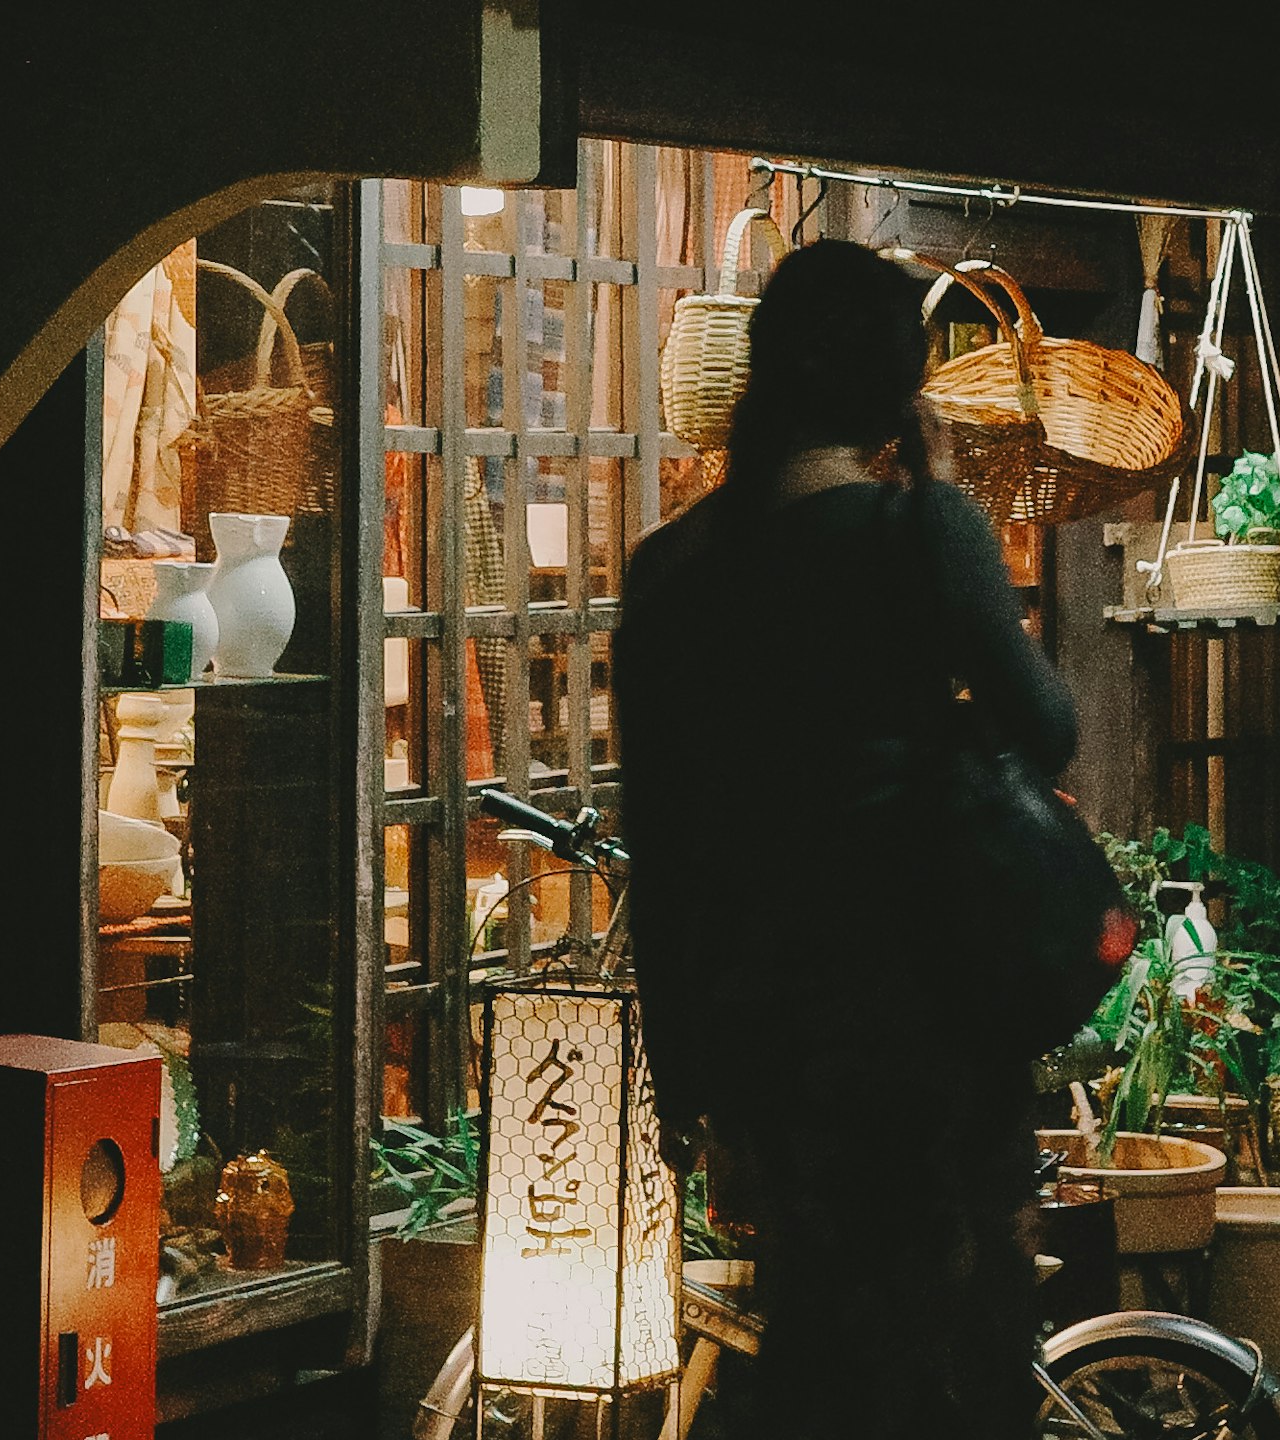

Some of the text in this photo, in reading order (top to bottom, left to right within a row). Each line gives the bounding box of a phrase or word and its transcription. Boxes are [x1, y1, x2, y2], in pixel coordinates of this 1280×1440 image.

[524, 1037, 591, 1257] グランピエ
